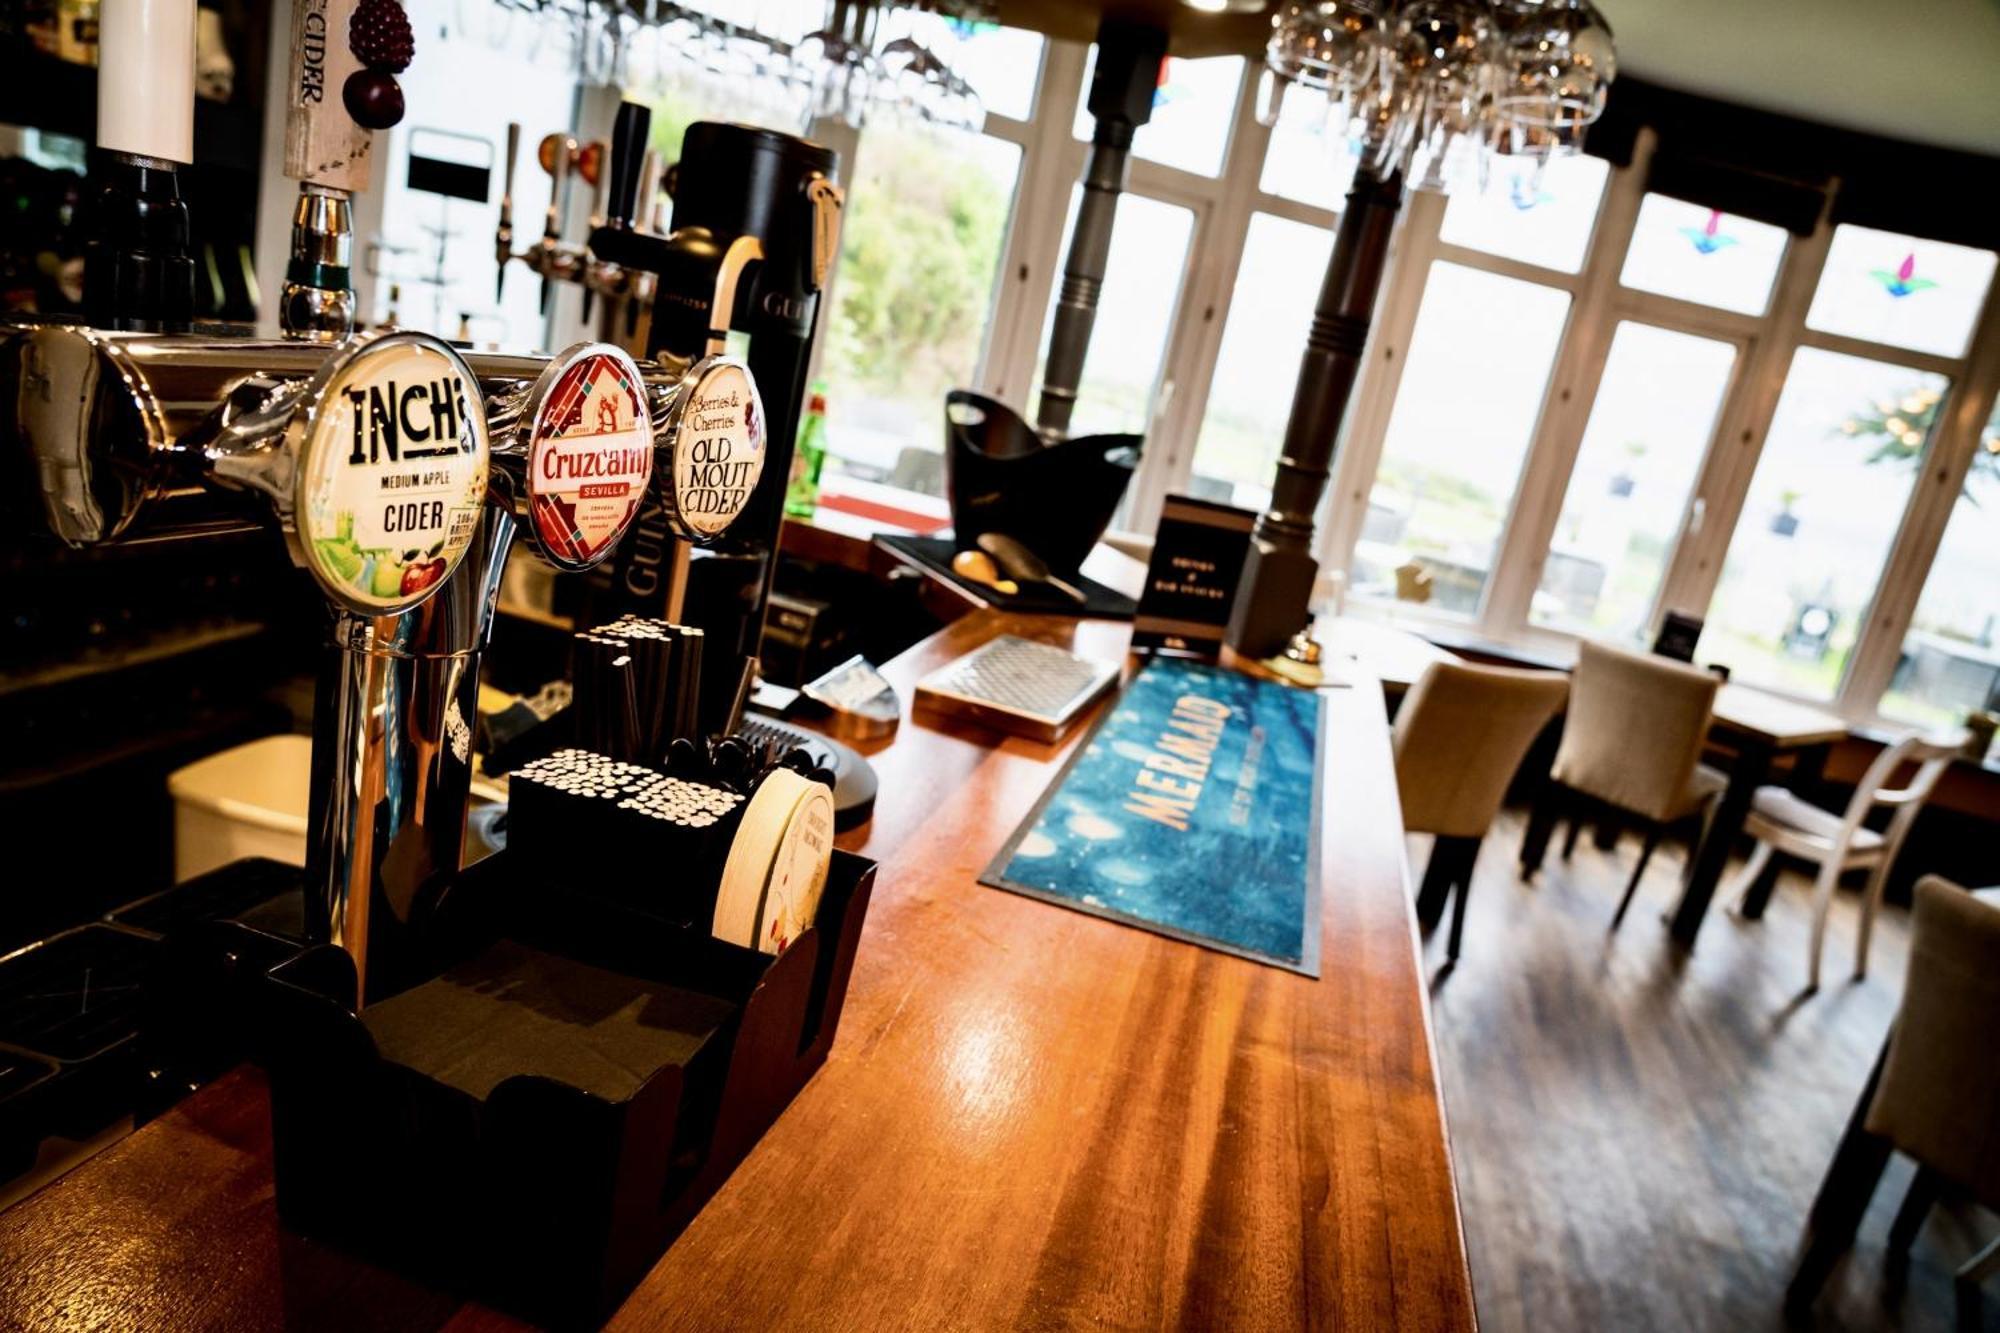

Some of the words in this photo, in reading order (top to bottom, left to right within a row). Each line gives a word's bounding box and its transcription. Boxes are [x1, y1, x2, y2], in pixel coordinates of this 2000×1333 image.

[302, 12, 326, 104] CIDER
[694, 395, 730, 413] Berries
[693, 413, 735, 432] Cherries
[692, 438, 731, 463] OLD
[381, 474, 420, 489] MEDIUM
[423, 471, 450, 485] APPLE
[689, 462, 754, 488] MOUT
[584, 485, 625, 496] SEVILLA
[684, 489, 745, 514] CIDER
[384, 501, 444, 533] CIDER
[1122, 695, 1231, 832] MERMAID
